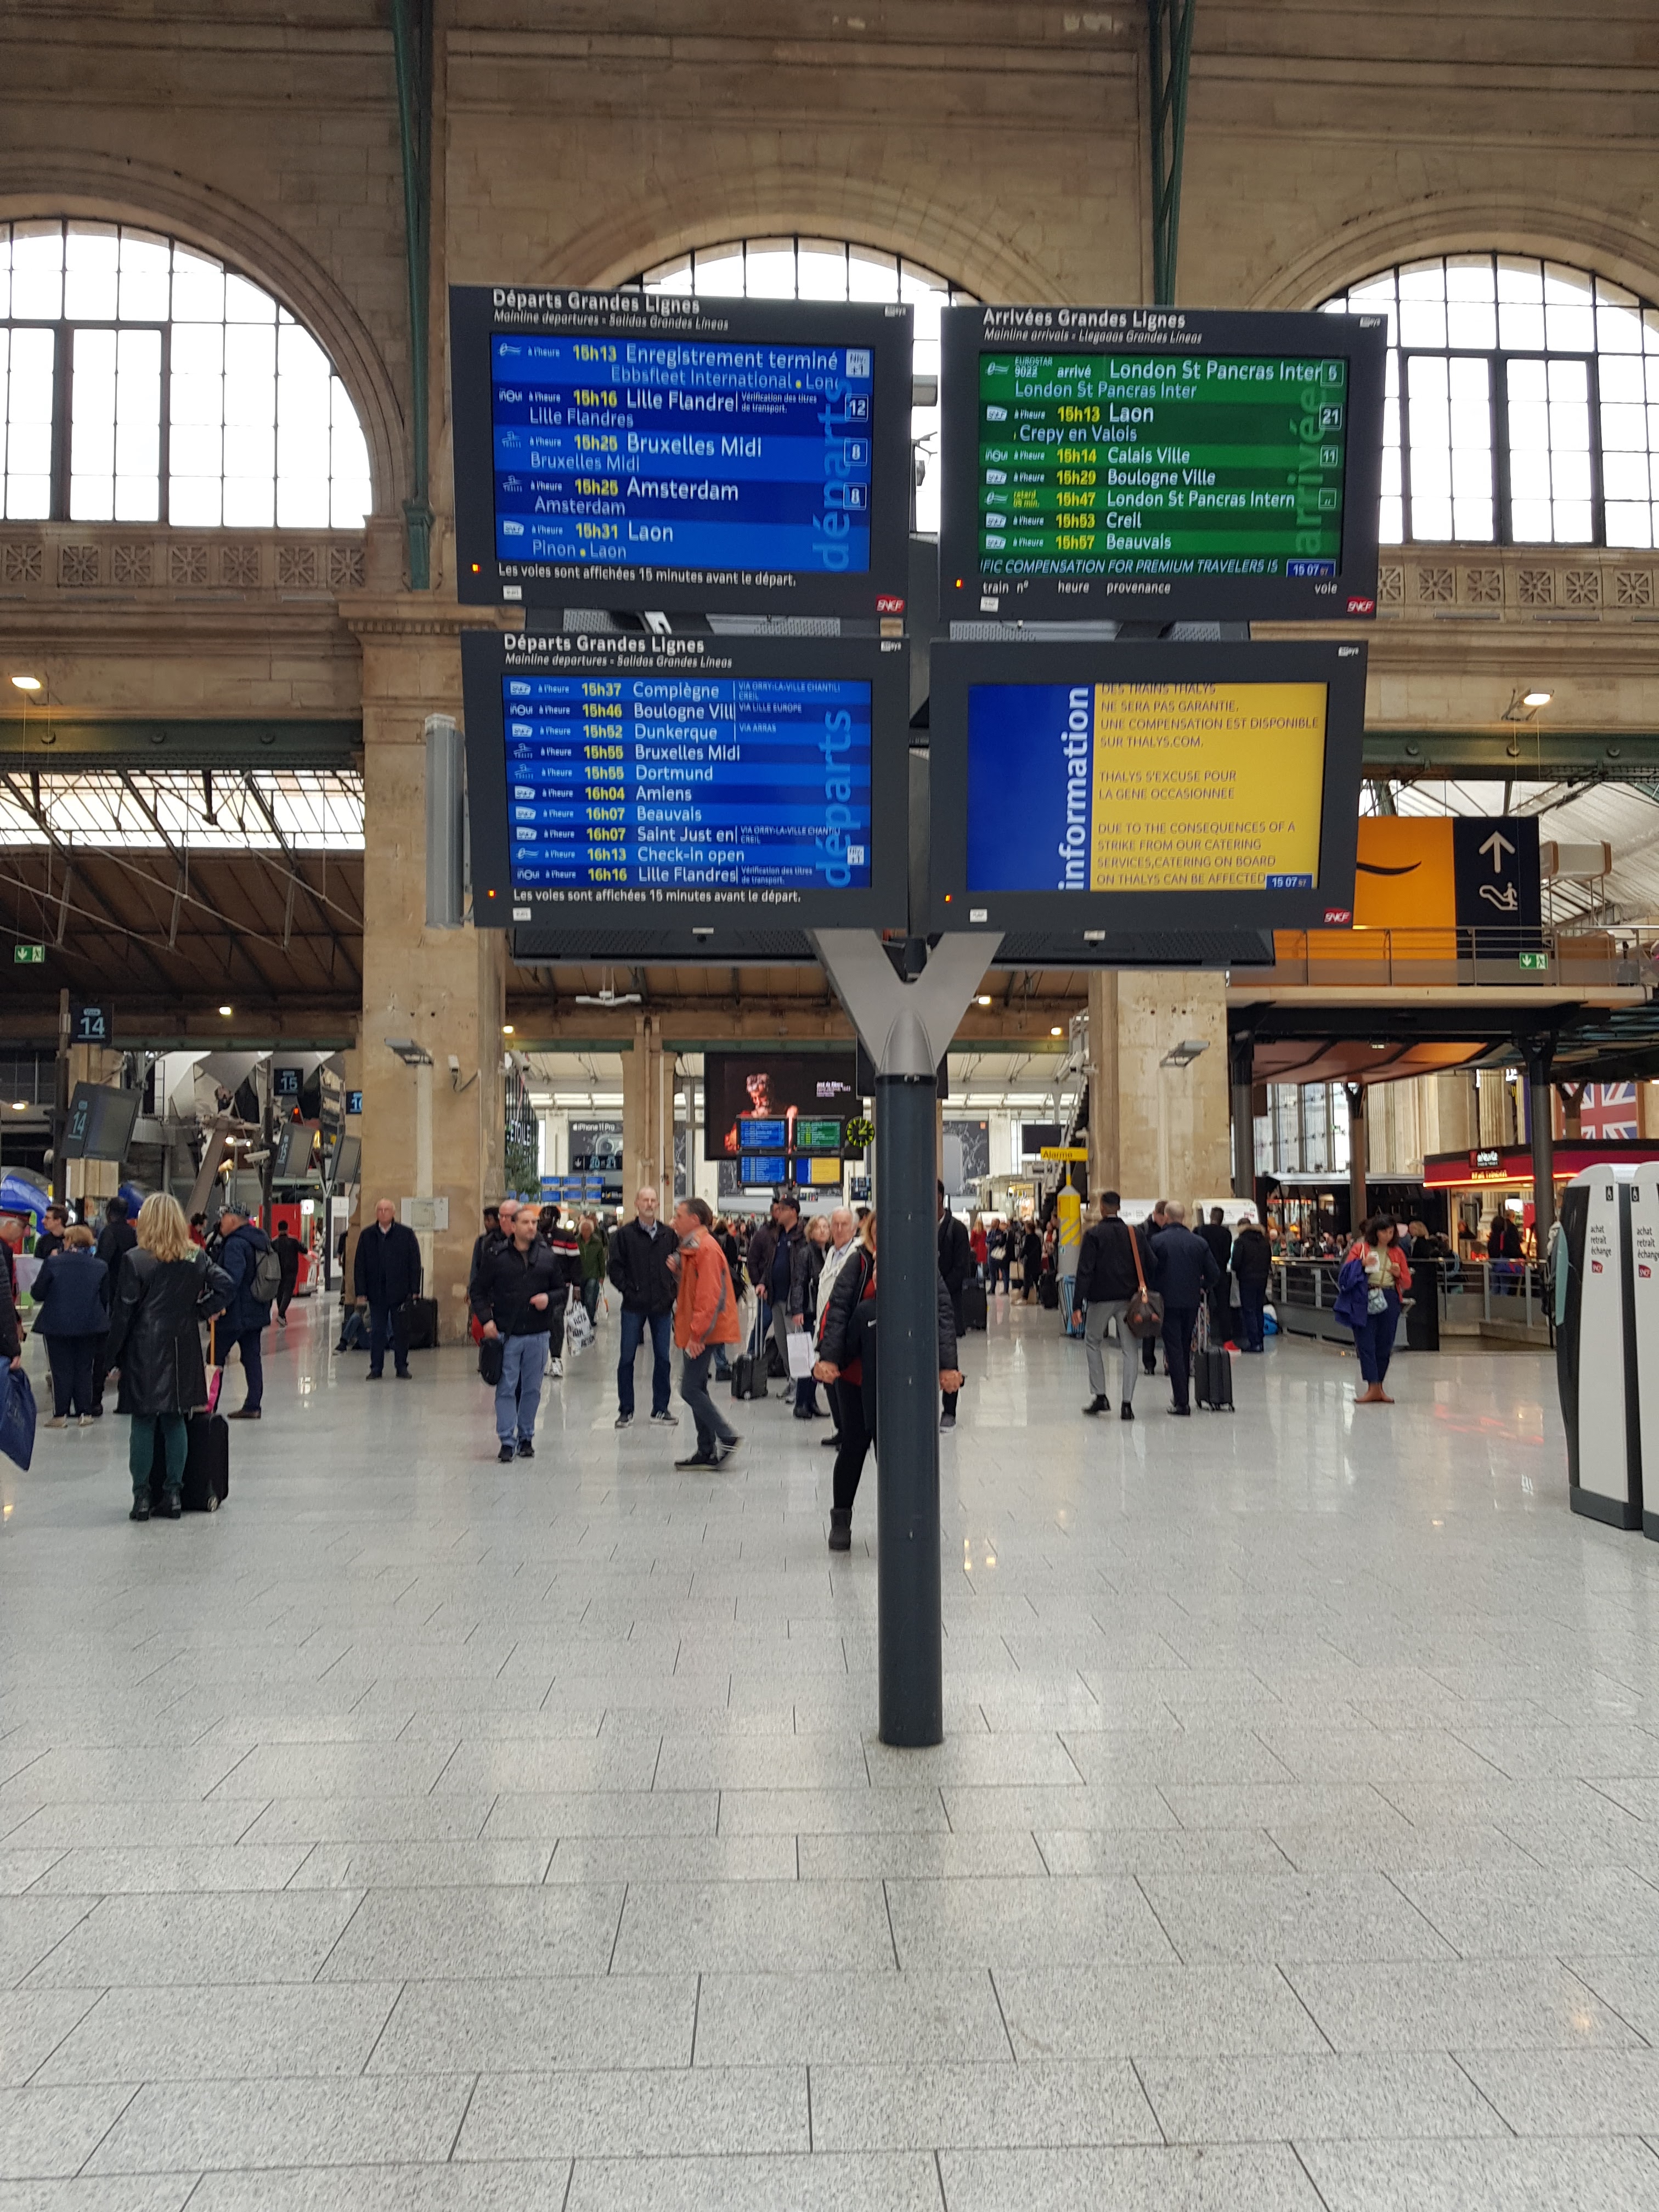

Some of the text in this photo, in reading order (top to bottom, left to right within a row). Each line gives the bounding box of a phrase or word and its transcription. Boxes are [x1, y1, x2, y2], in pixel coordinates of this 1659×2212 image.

[493, 289, 700, 315] Départs Grandes Lignes
[494, 308, 692, 329] Mainline departures Salidas Grandes
[983, 309, 1185, 329] Arrivées Grandes Lignes
[984, 329, 1167, 343] Mainline arrivals Grandes
[627, 343, 838, 371] Enregistrement terminé
[611, 366, 792, 388] Ebbsfleet International
[1057, 360, 1274, 382] arrivé London St Pancras
[627, 388, 663, 409] Lille
[1015, 382, 1197, 399] London St Pancras Inter
[849, 400, 865, 416] 12
[1109, 404, 1154, 422] Laon
[530, 407, 633, 428] Lille Flandres
[1323, 409, 1339, 425] 21
[1020, 425, 1137, 444] Crepy en Valois
[628, 432, 761, 457] Bruxelles Midi
[531, 453, 639, 472] Bruxelles Midi
[1108, 448, 1189, 464] Calais Ville
[1324, 450, 1335, 463] 11
[1108, 469, 1215, 489] Boulogne Ville
[627, 476, 738, 501] Amsterdam
[535, 495, 625, 516] Amsterdam
[1107, 490, 1294, 507] London St Pancras Intern
[1107, 511, 1141, 528] Creil
[628, 520, 673, 542] Laon
[590, 541, 626, 558] Laon
[1107, 534, 1171, 550] Beauvais
[499, 563, 751, 585] Les voies sont affichées minutes avant le
[1006, 559, 1264, 574] COMPENSATION FOR PREMIUM TRAVELERS
[983, 582, 1009, 594] train
[1057, 581, 1090, 594] heure
[1107, 582, 1170, 597] provenance
[1315, 582, 1338, 594] voie
[504, 634, 704, 657] Départs Grandes Lignes
[505, 653, 698, 669] Mainline departures Grandes
[633, 682, 719, 702] Compiègne
[634, 702, 706, 724] Boulogne
[1102, 701, 1175, 713] NE SERA PAS
[1101, 717, 1318, 730] UNE COMPENSATION EST DISPONIBLE
[635, 724, 717, 743] Dunkerque
[1101, 736, 1123, 748] SUR
[635, 744, 740, 761] Bruxelles Midi
[636, 765, 713, 781] Dortmund
[1100, 771, 1236, 783] THALYS S'EXCUSE POUR
[636, 785, 692, 801] Amiens
[1058, 686, 1088, 890] information
[1099, 788, 1234, 800] LA GENE OCCASIONNEE
[637, 805, 701, 821] Beauvais
[637, 826, 733, 843] Saint Just en
[1098, 821, 1295, 835] DUE TO THE CONSEQUENCES OF A
[1098, 839, 1261, 851] STRIKE FROM OUR CATERING
[637, 846, 744, 865] Check-in open
[1215, 856, 1275, 868] ON BOARD
[638, 867, 736, 884] Lille Flandres
[1097, 873, 1265, 885] ON THALYS CAN BE AFFECTED
[514, 889, 759, 902] Les voies sont affichées minutes avant le
[80, 1017, 105, 1035] 14
[72, 1111, 87, 1136] 14
[578, 1122, 598, 1131] iPhone
[605, 1122, 615, 1131] Pro
[1043, 1150, 1073, 1158] Alarme
[1590, 1224, 1605, 1233] achat
[1637, 1226, 1652, 1235] achat
[1590, 1235, 1606, 1244] retrait
[1637, 1238, 1655, 1248] retrait
[1591, 1246, 1612, 1257] échange
